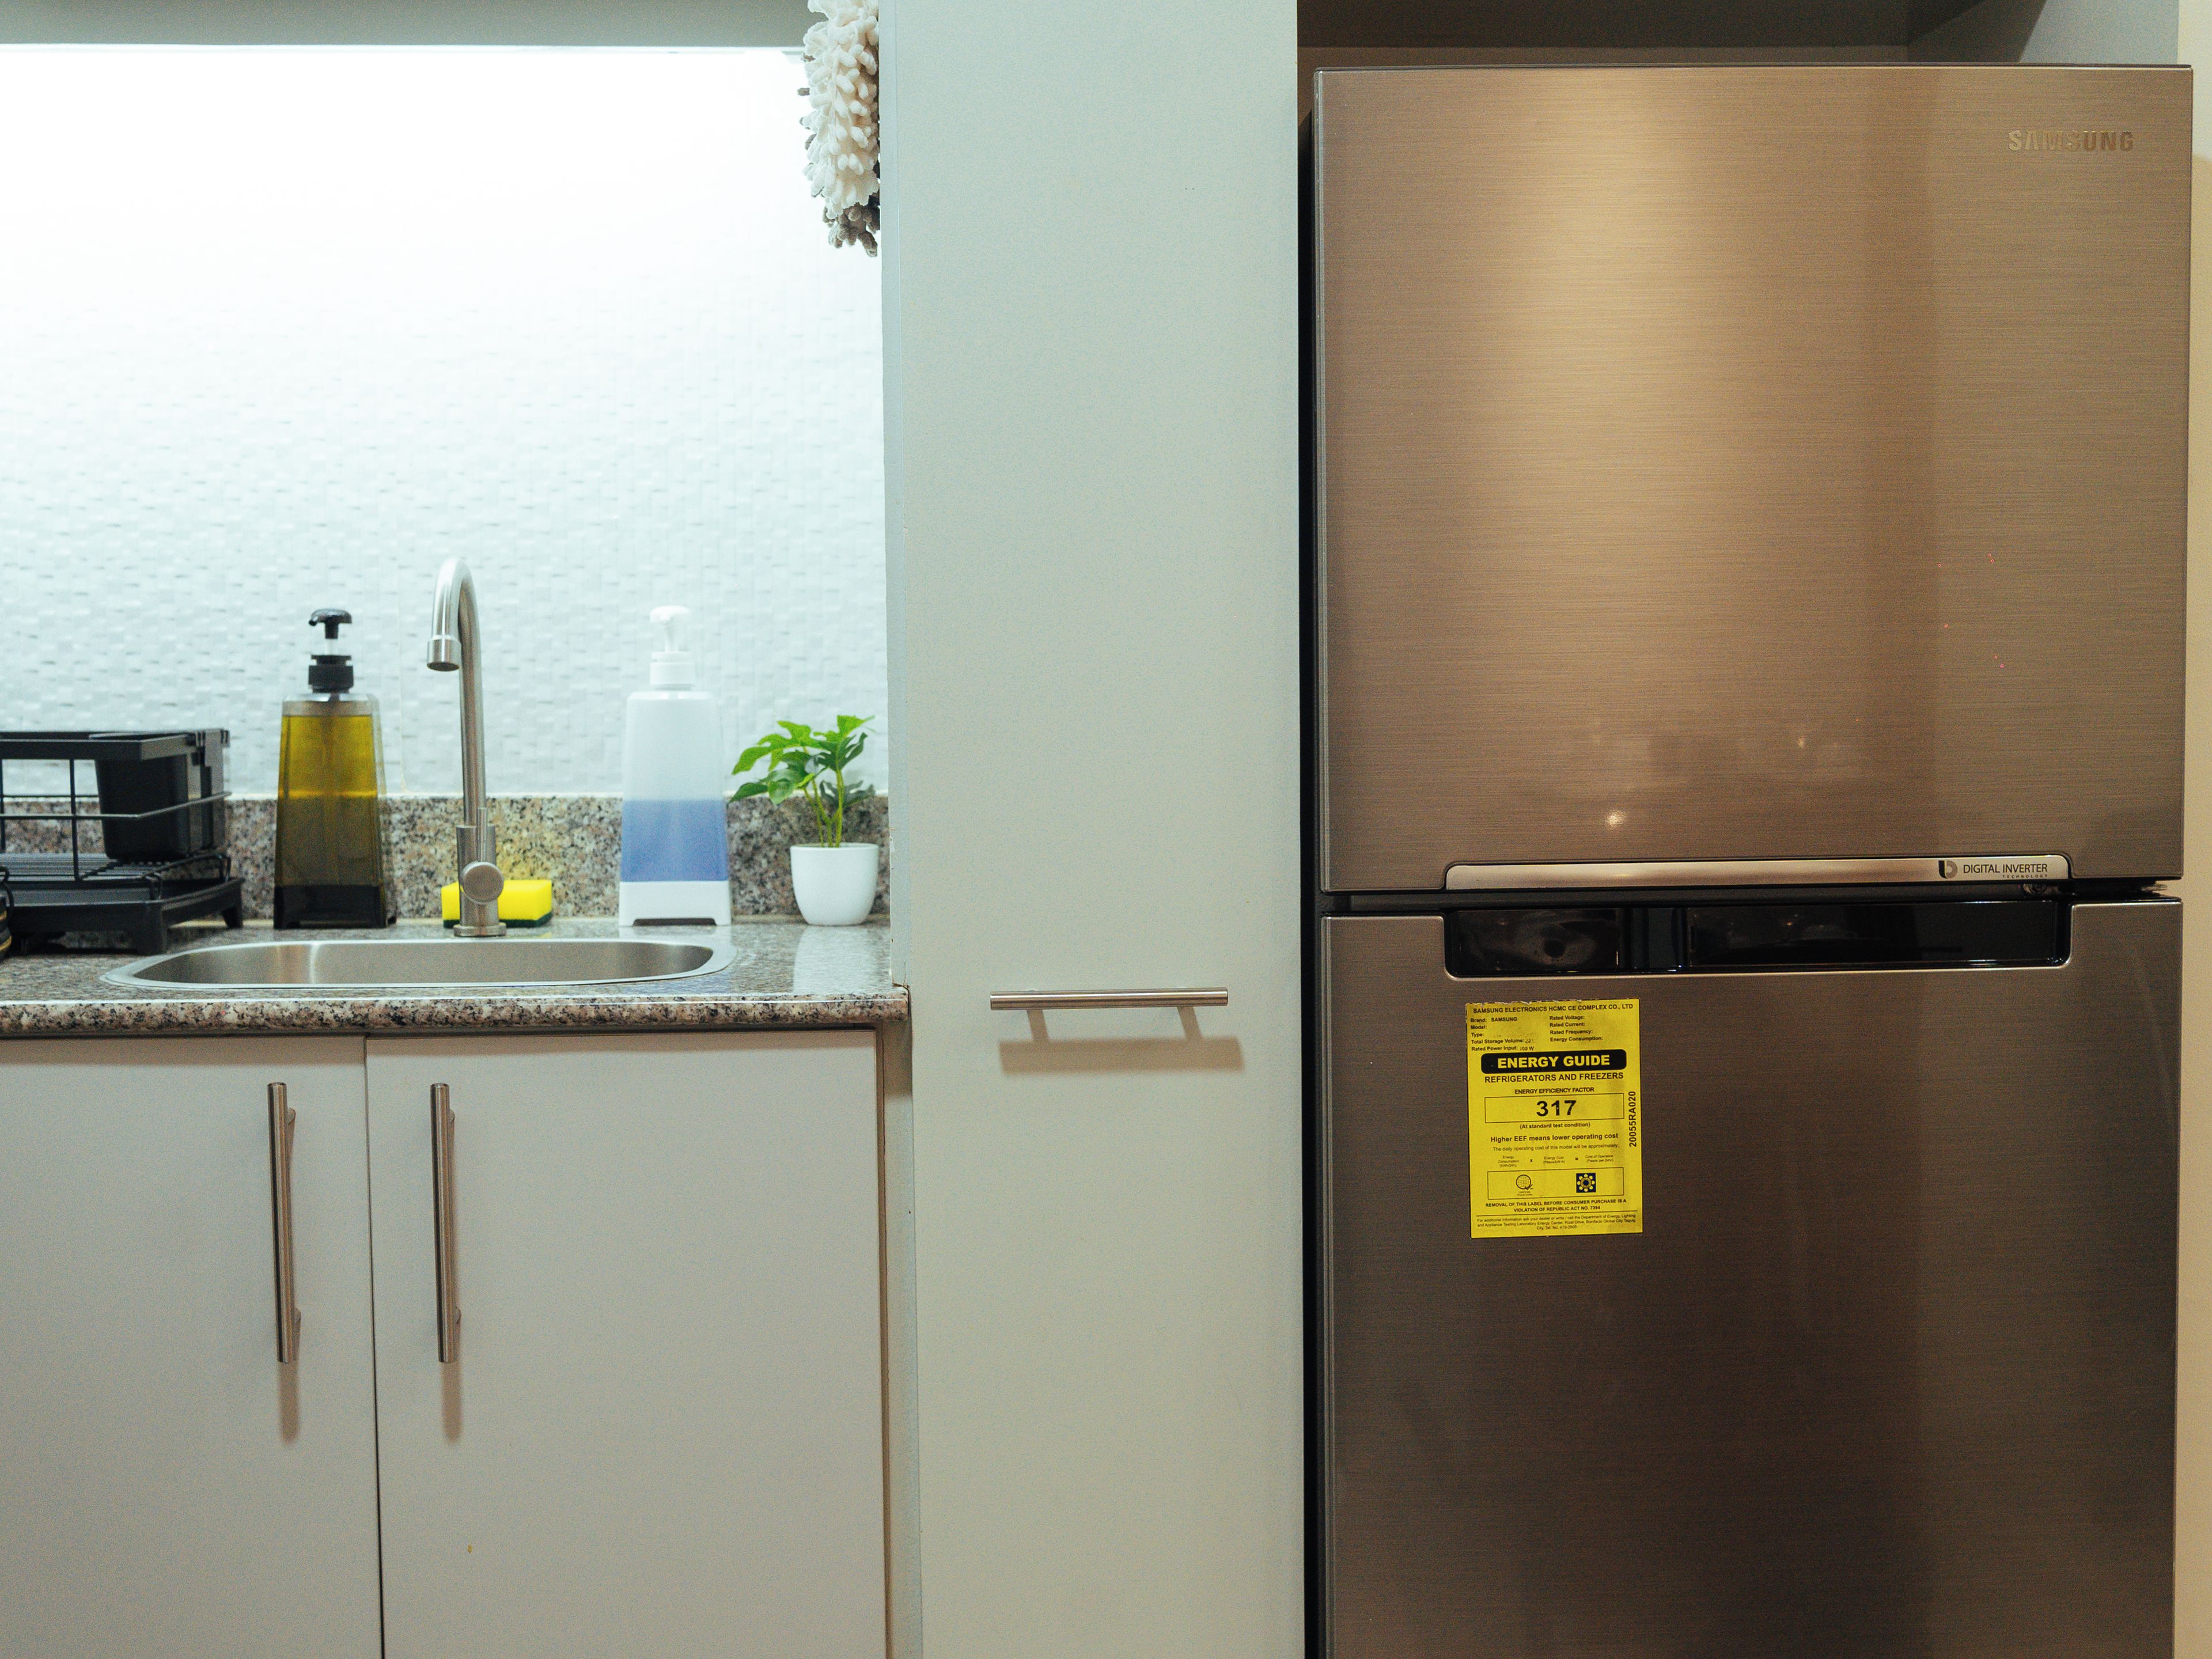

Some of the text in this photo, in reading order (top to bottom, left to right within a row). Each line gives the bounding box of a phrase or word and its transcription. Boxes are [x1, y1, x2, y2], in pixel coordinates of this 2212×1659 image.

[2008, 130, 2133, 151] SAMSUNG
[1963, 863, 2048, 873] DIGITAL INVERTER
[1498, 1055, 1610, 1069] ENERGY GUIDE
[1484, 1074, 1556, 1083] REFRIGERATORS
[1580, 1072, 1623, 1080] FREEZERS
[1536, 1100, 1577, 1117] 317
[1628, 1091, 1637, 1147] 20055RA020
